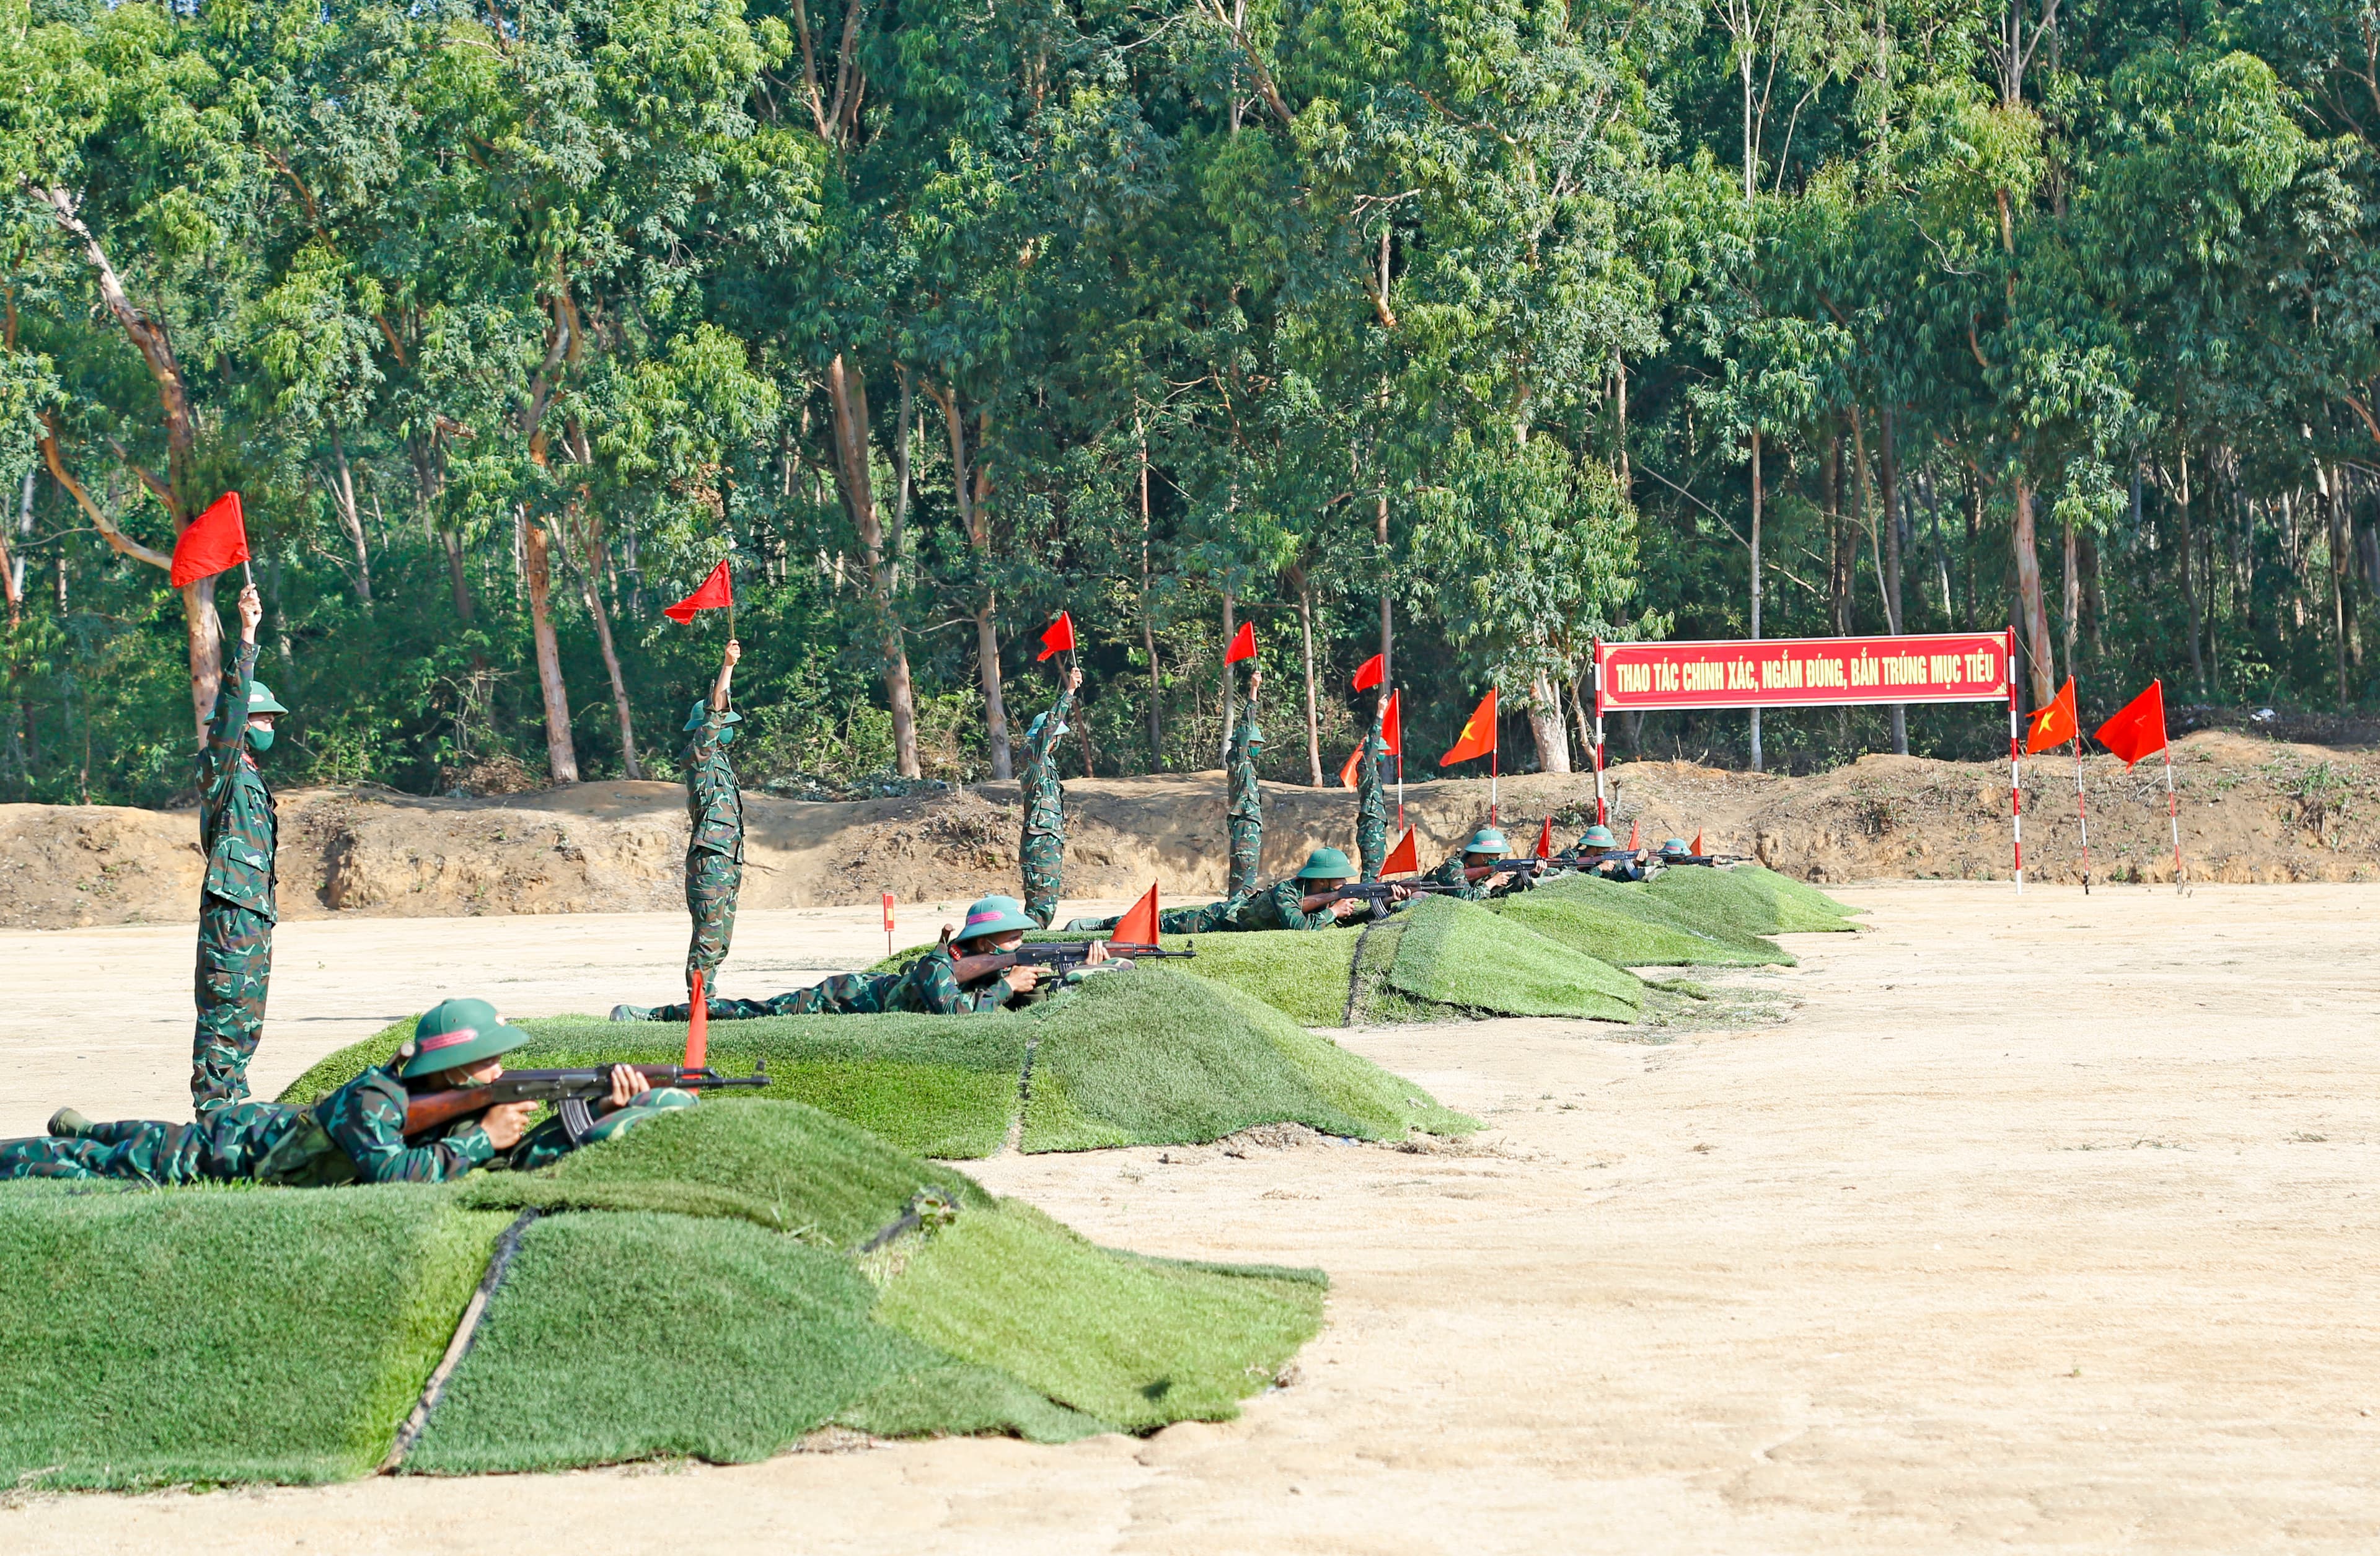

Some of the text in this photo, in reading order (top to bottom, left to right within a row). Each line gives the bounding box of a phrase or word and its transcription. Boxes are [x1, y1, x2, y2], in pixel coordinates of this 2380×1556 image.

[1616, 646, 1994, 692] THAO TÁC CHÍNH XÁC, NGẮM ĐÚNG, BẮN TRÚNG MỤC TIÊU
